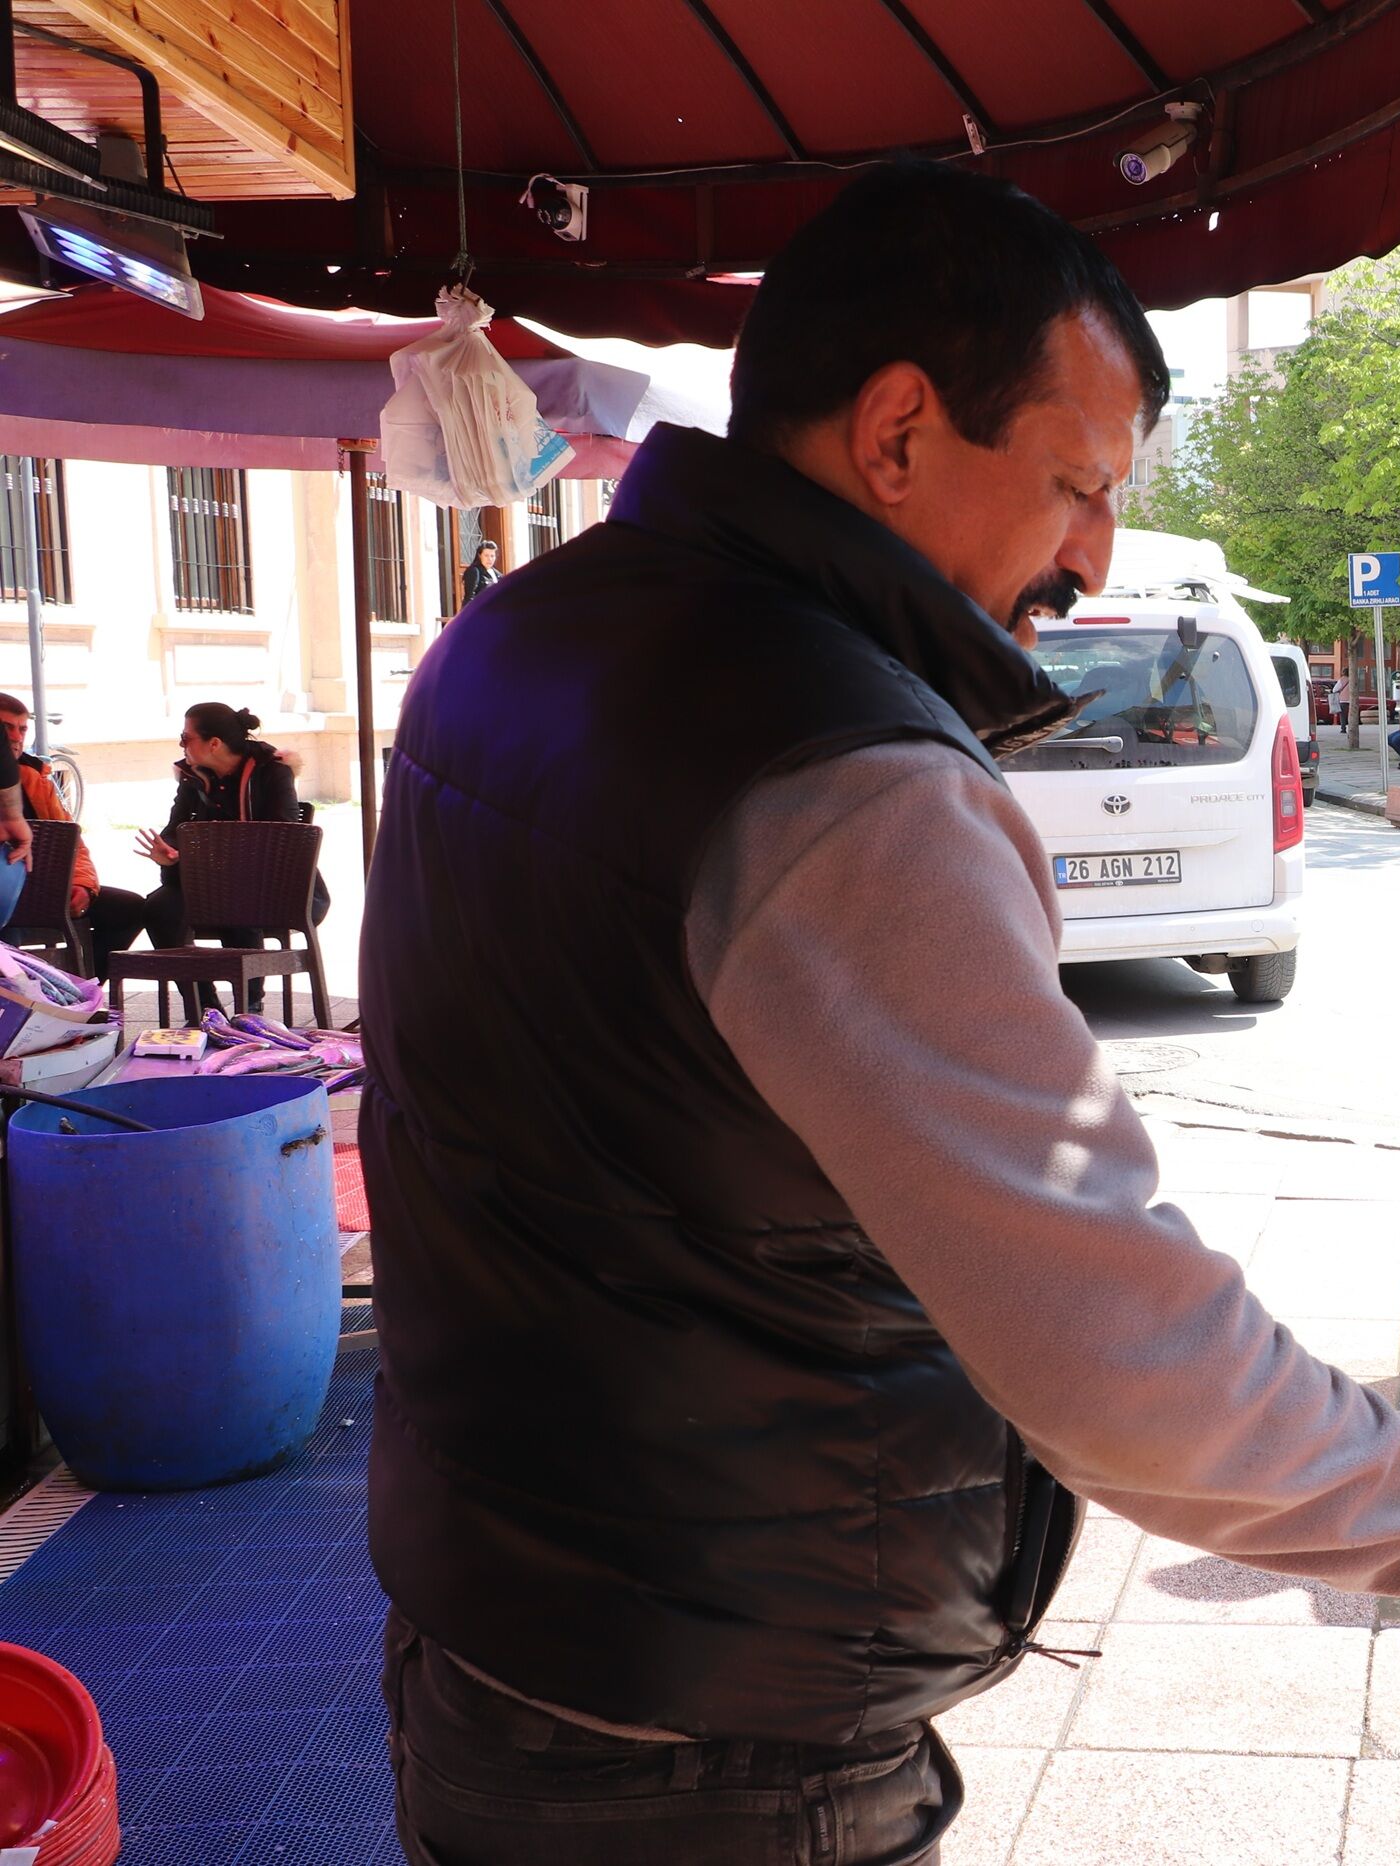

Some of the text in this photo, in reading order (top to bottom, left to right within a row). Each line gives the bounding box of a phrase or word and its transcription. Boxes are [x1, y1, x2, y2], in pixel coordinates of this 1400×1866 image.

[1353, 556, 1380, 596] P
[1191, 793, 1265, 804] PROACE CITY
[1068, 856, 1176, 880] 26 AGN 212
